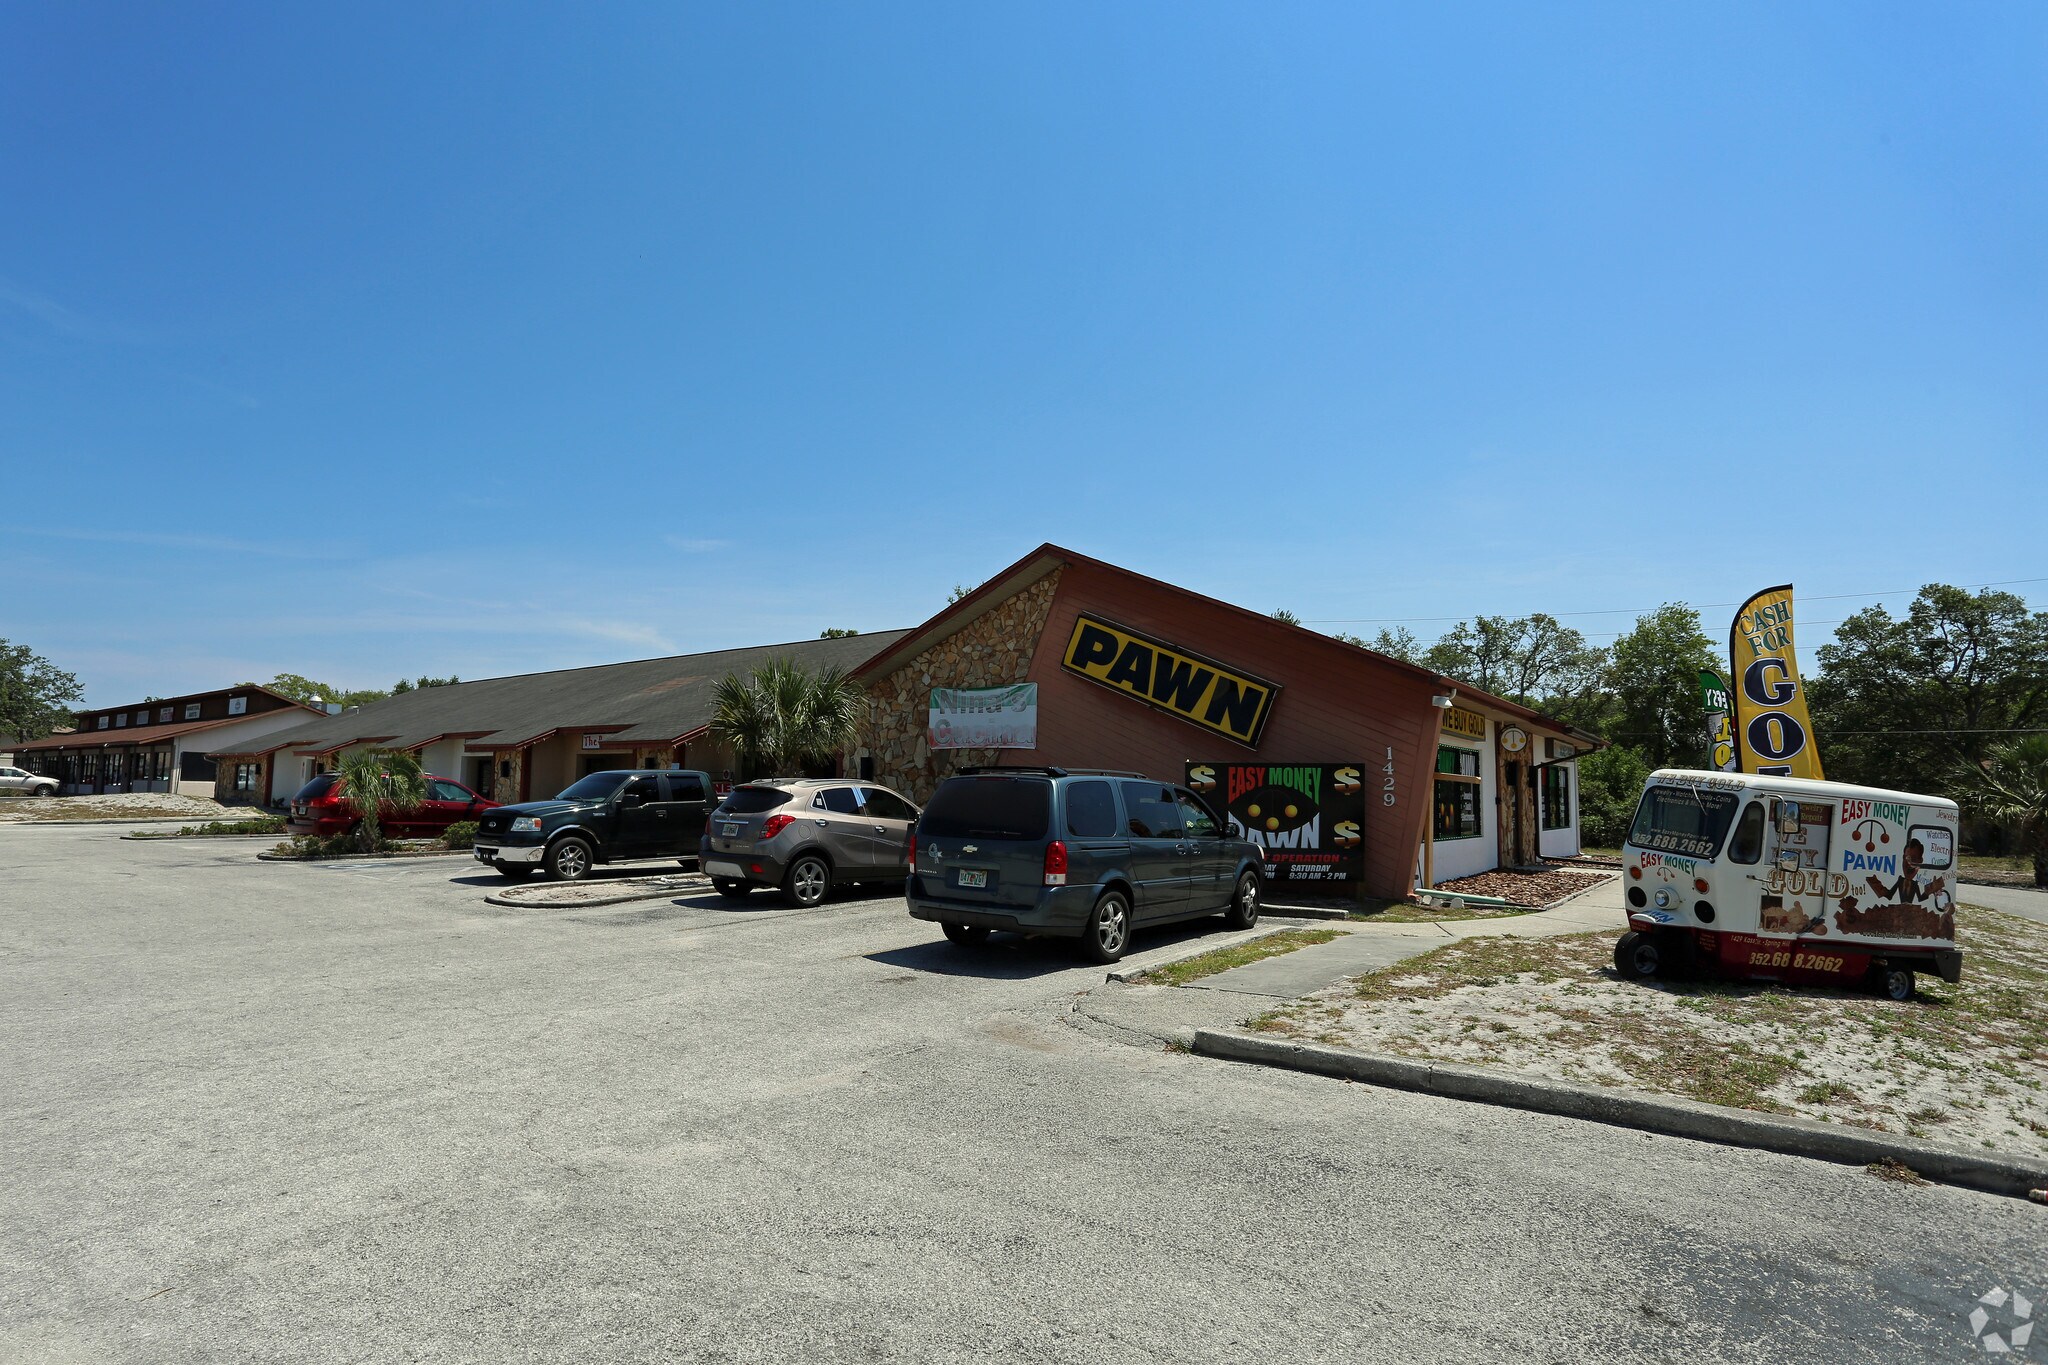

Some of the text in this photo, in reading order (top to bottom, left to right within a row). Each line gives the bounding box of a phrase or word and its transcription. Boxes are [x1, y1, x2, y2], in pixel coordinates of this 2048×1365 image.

[1740, 600, 1792, 636] CASH
[1747, 626, 1792, 657] FOR
[1071, 623, 1264, 737] PAWN
[939, 689, 1027, 715] Nina's
[584, 736, 597, 746] The
[1228, 766, 1266, 805] EASY
[1269, 767, 1322, 806] MONEY
[1706, 777, 1746, 792] GOLD
[1800, 805, 1824, 814] ewelry
[1801, 813, 1823, 823] Repair
[1841, 799, 1912, 830] EASY MONEY
[1936, 809, 1959, 824] Jewelry
[1633, 833, 1714, 856] 352.688.2662
[1926, 830, 1950, 841] Watches
[1271, 854, 1340, 862] OPERATION
[1290, 864, 1331, 872] SATURDAY
[1640, 851, 1697, 877] EASY MONEY
[1843, 850, 1896, 876] PAWN
[1767, 868, 1866, 898] GOLD too!
[1764, 939, 1781, 948] Spring
